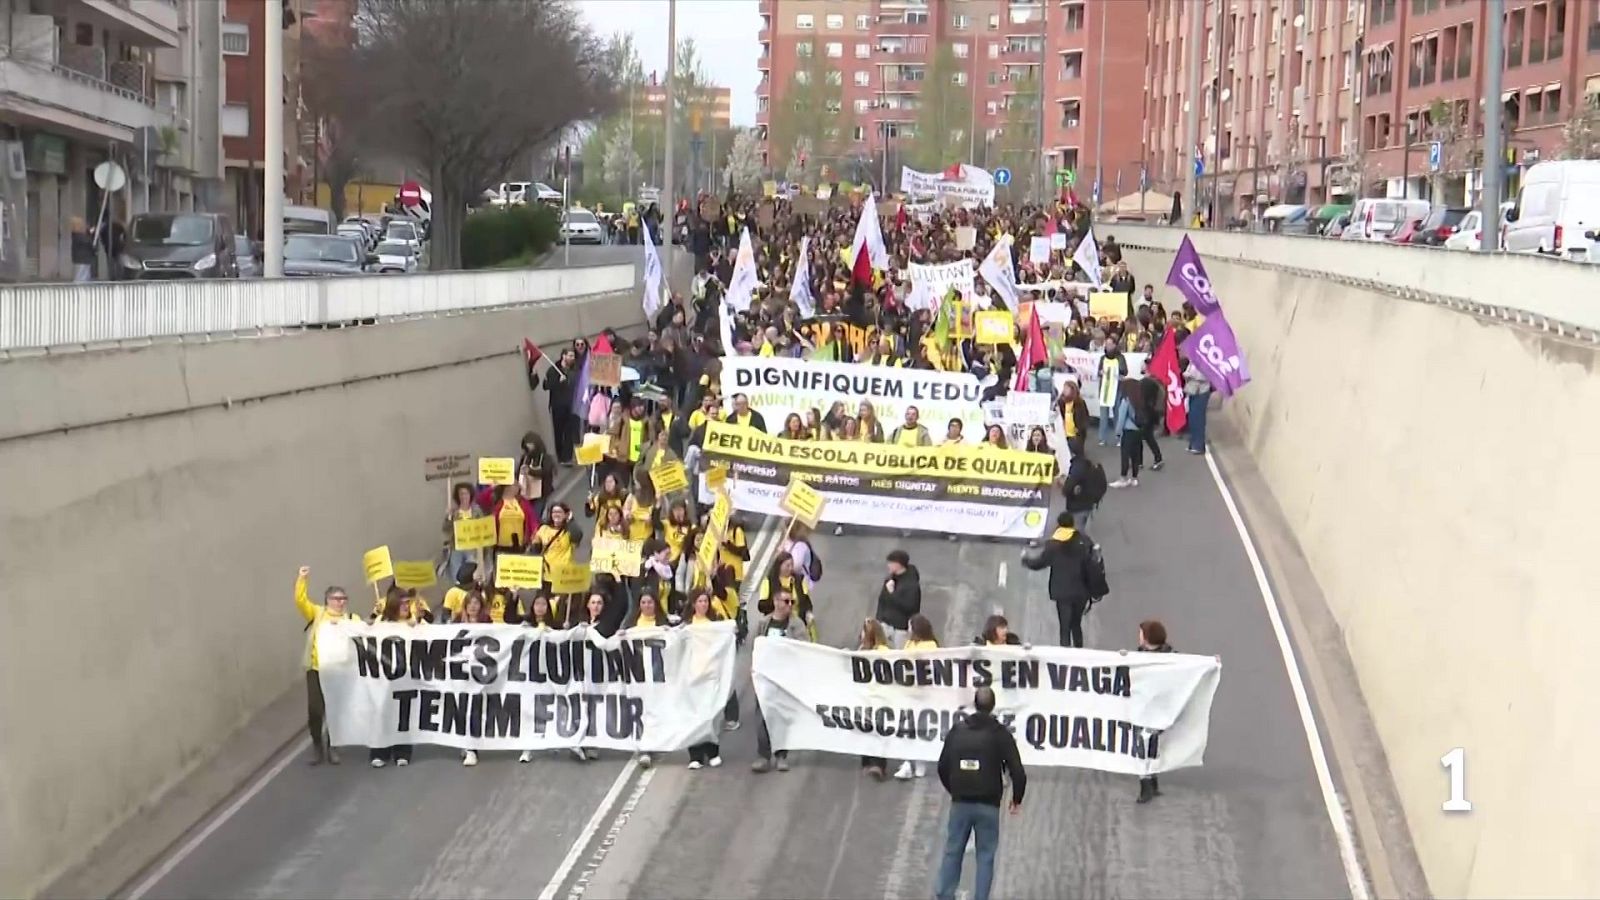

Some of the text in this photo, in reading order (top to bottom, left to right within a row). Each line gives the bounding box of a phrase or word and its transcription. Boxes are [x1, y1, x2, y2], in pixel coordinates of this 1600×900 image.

[736, 367, 903, 398] DIGNIFIQUEM
[708, 431, 1053, 478] PER UNA ESCOLA PÚBLICA DE QUALITAT
[733, 462, 777, 478] INVERSIÓ
[790, 471, 860, 486] MENYS RÀTIOS
[871, 479, 937, 492] MÉS DIGNITAT
[947, 485, 979, 495] MENYS
[352, 630, 667, 686] NOMÉS LLUITANT
[851, 655, 1132, 697] DOCENTS EN VAGA
[393, 690, 645, 741] TENIM FUTUR
[1025, 712, 1165, 760] QUALITAT
